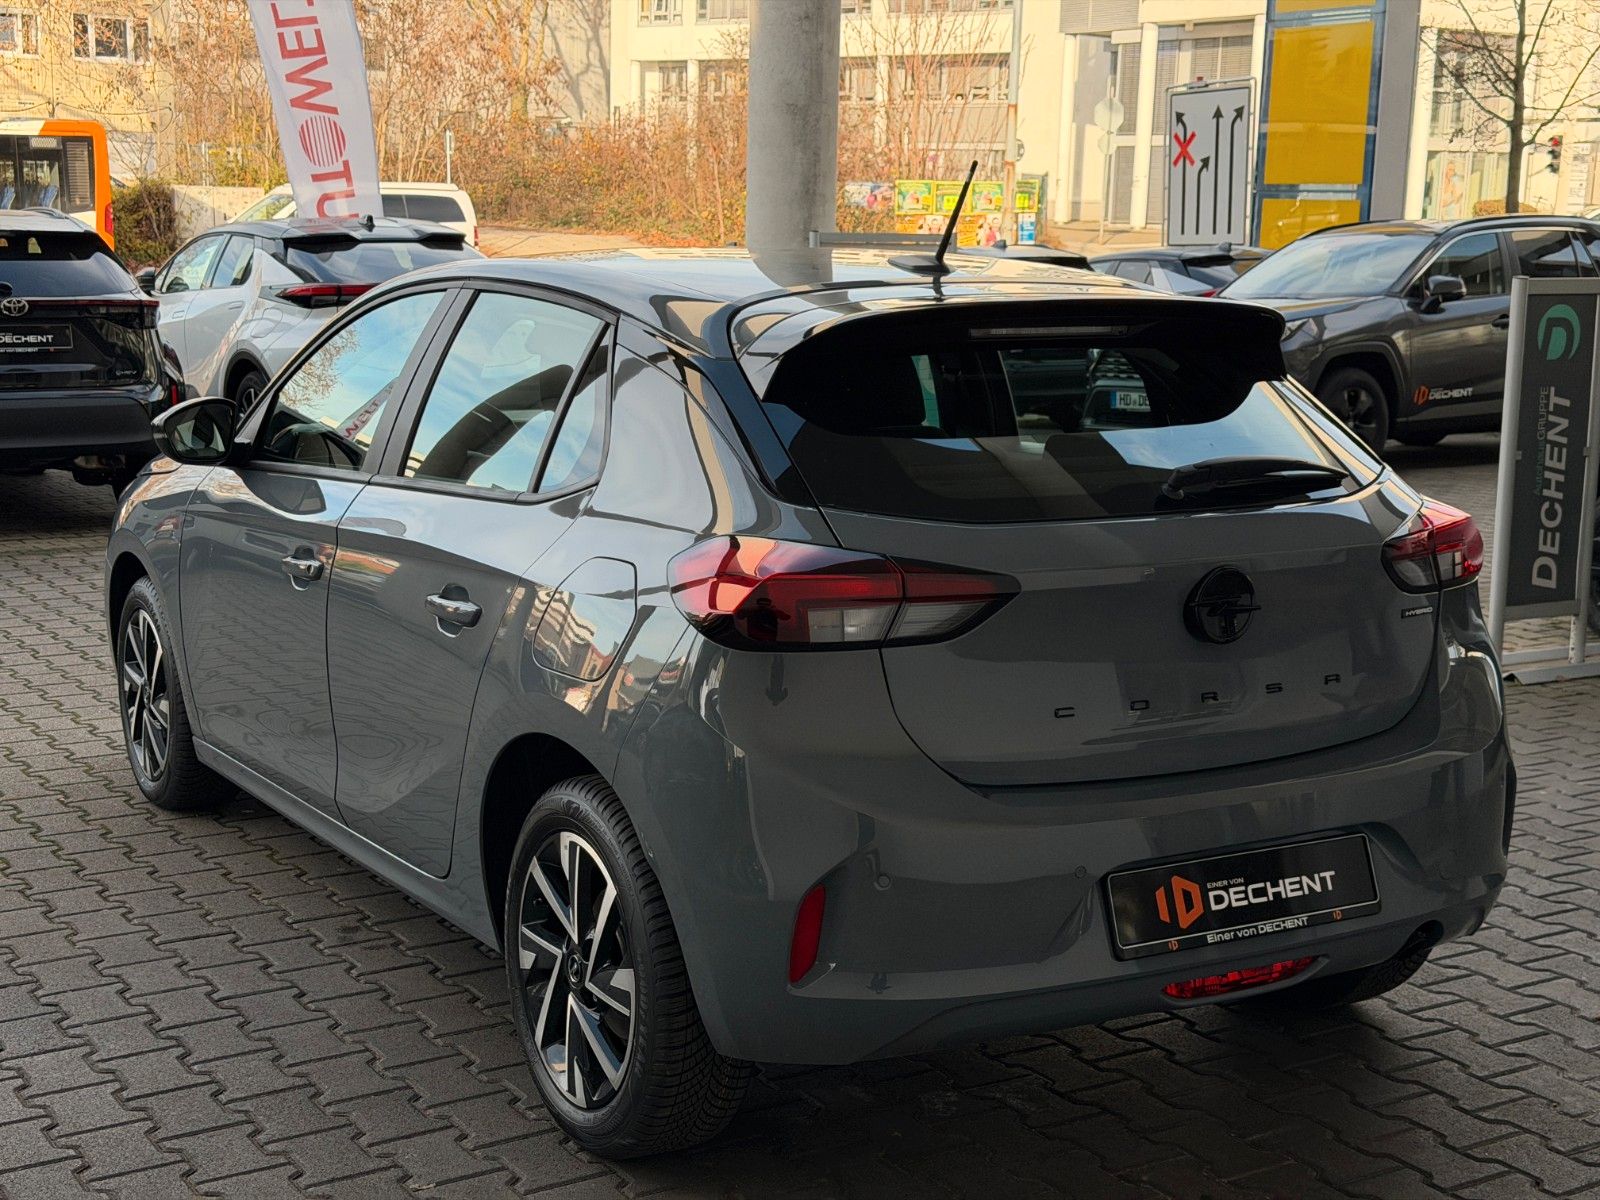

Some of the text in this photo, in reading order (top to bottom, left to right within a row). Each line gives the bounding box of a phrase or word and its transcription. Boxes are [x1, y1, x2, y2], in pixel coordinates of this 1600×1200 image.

[1119, 393, 1132, 406] HD
[1428, 387, 1473, 400] DECHENT
[1531, 386, 1571, 590] DECHENT
[1054, 673, 1341, 719] CORSA
[1207, 877, 1244, 889] EINER VON
[1208, 871, 1336, 912] DECHENT
[1207, 917, 1309, 944] Einer von DECHENT
